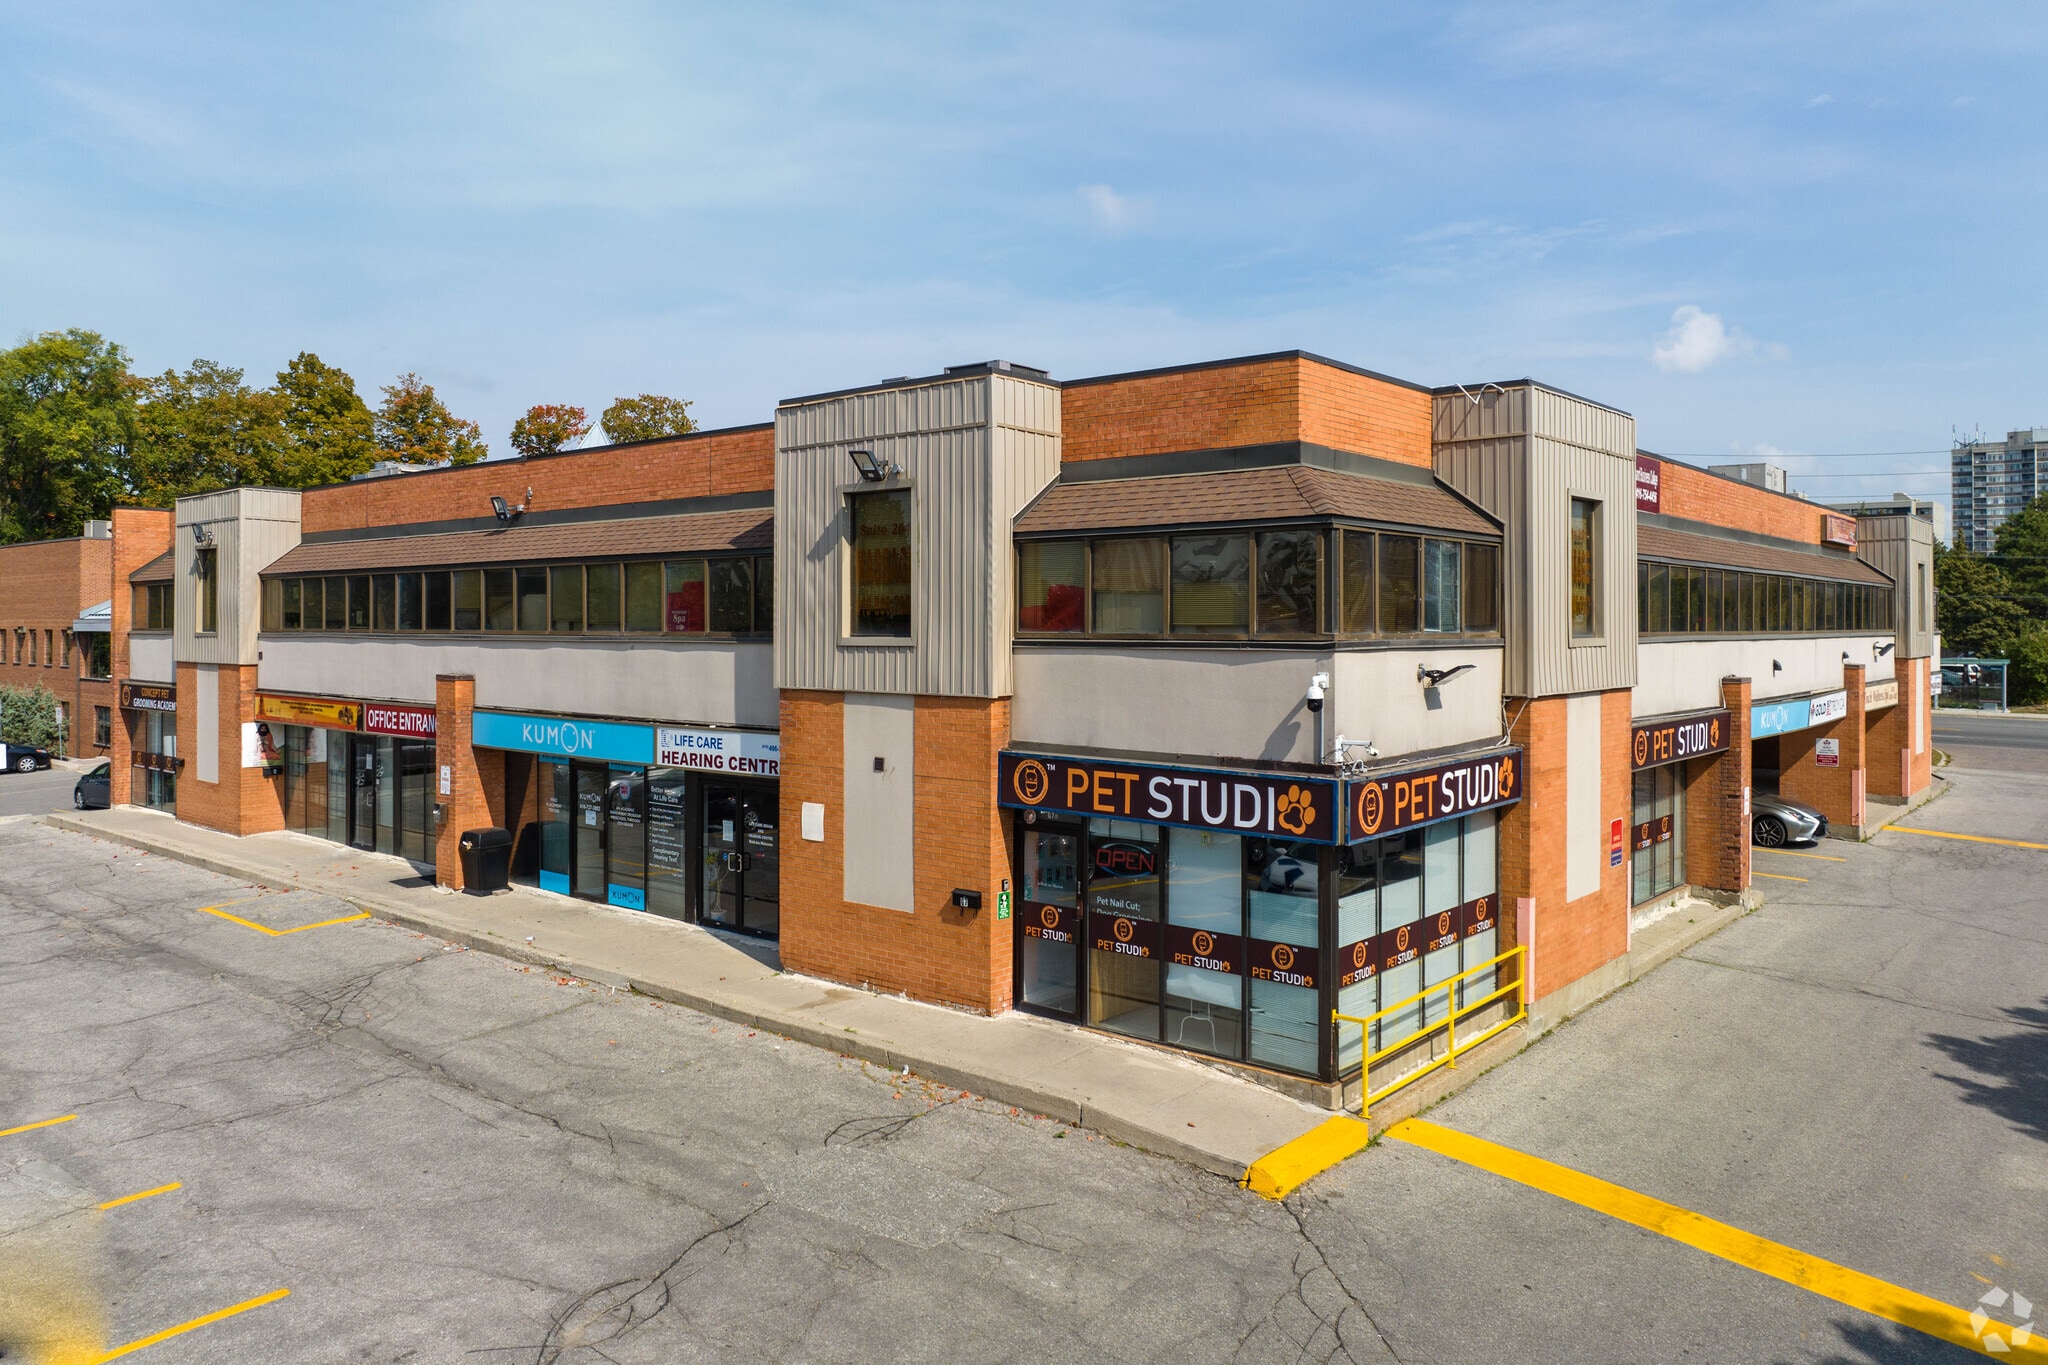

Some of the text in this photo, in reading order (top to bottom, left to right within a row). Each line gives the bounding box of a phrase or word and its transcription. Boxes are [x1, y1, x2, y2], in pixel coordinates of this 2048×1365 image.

[673, 614, 686, 624] Spa
[133, 697, 157, 709] GROOMING
[368, 709, 437, 732] OFFICE ENTRAN
[523, 722, 593, 753] KUMON
[674, 734, 694, 747] LIFE
[696, 736, 723, 750] CARE
[1653, 727, 1675, 761] PET
[661, 750, 779, 775] HEARING CENTR
[1066, 767, 1140, 815] PET
[1395, 774, 1438, 826] PET
[1095, 848, 1154, 872] OPEN
[612, 890, 640, 904] KUMON
[1096, 896, 1109, 906] Pet
[1110, 898, 1125, 909] Nail
[1026, 925, 1041, 937] PET
[1097, 939, 1114, 951] PET
[1174, 952, 1193, 965] PET
[1252, 966, 1272, 980] PET
